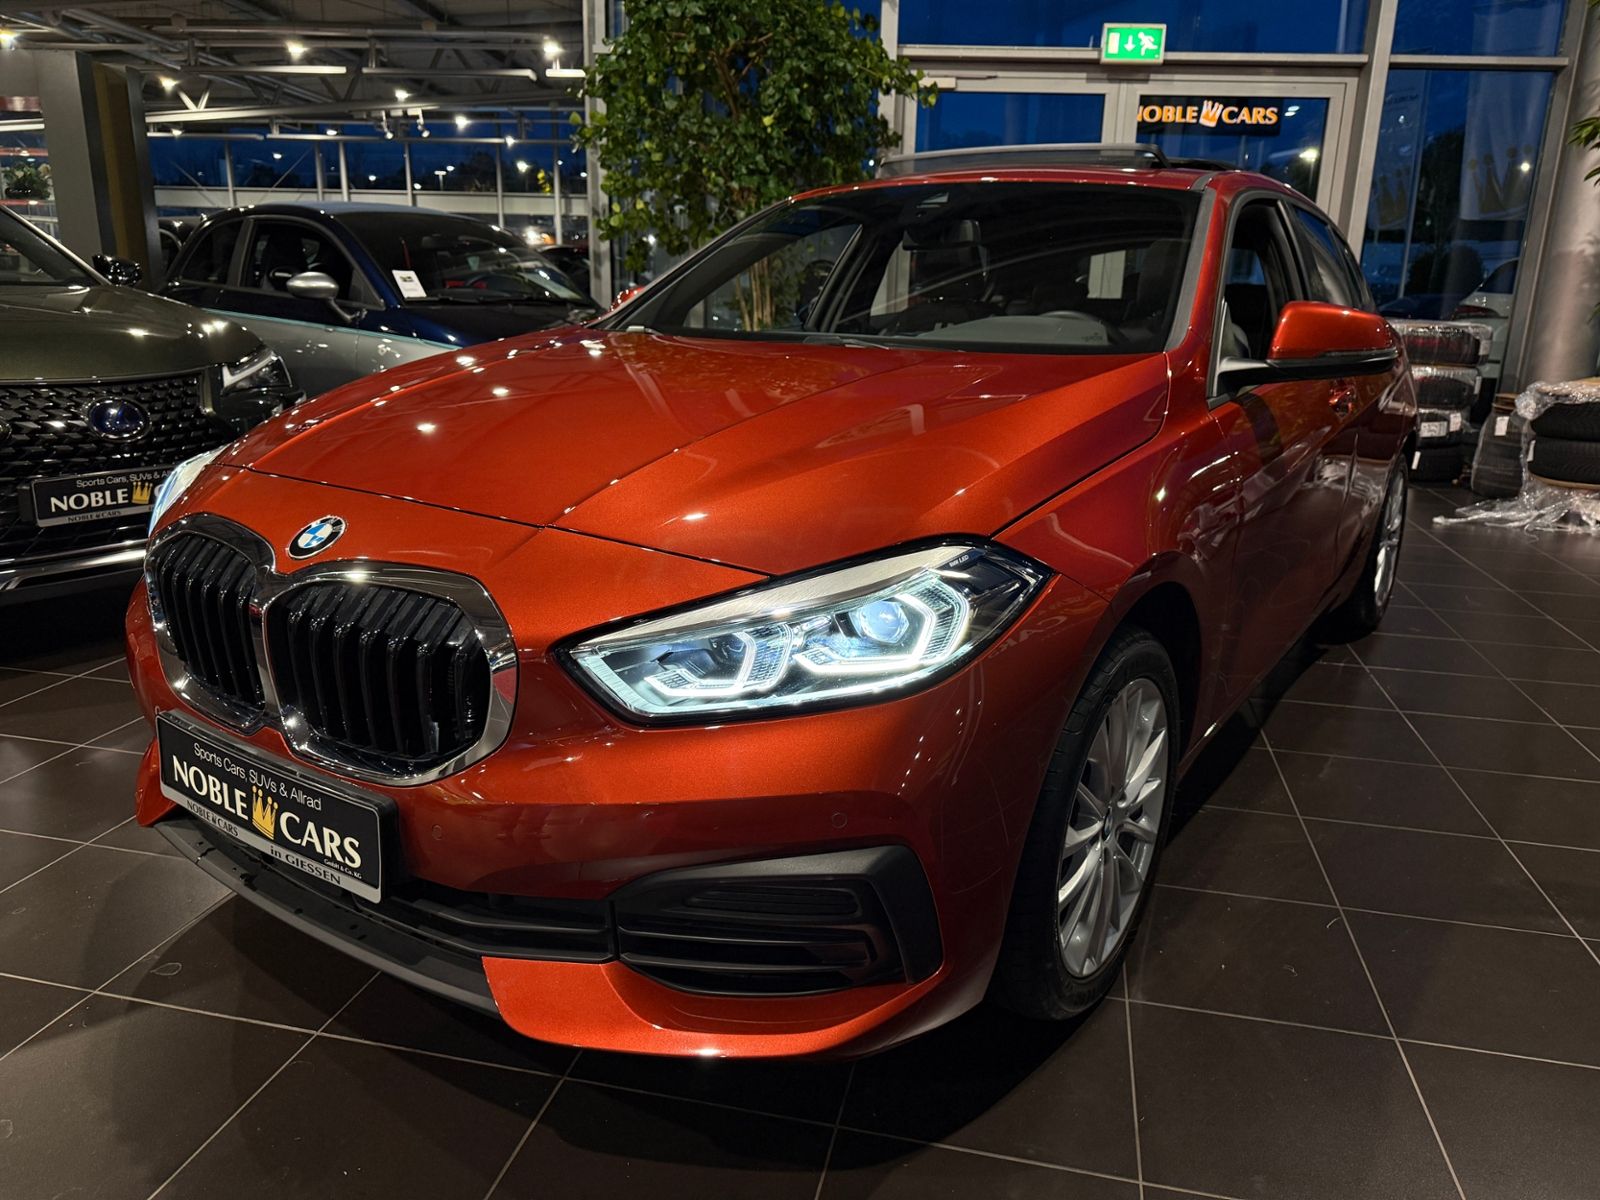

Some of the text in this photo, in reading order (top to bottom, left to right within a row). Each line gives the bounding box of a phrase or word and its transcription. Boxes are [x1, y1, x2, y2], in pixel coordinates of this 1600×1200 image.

[1221, 106, 1278, 124] CARS
[76, 478, 105, 488] Sports
[106, 475, 129, 484] Cars,
[129, 473, 152, 482] SUVs
[153, 471, 160, 479] &
[50, 488, 129, 512] NOBLE
[194, 742, 321, 811] Sports Cars, SUVs & Allrad
[172, 754, 361, 869] NOBLE CARS
[186, 799, 239, 837] NOBLE CARS
[270, 845, 341, 885] in GIESSEN
[323, 858, 340, 870] GmbH
[353, 871, 362, 880] KG
